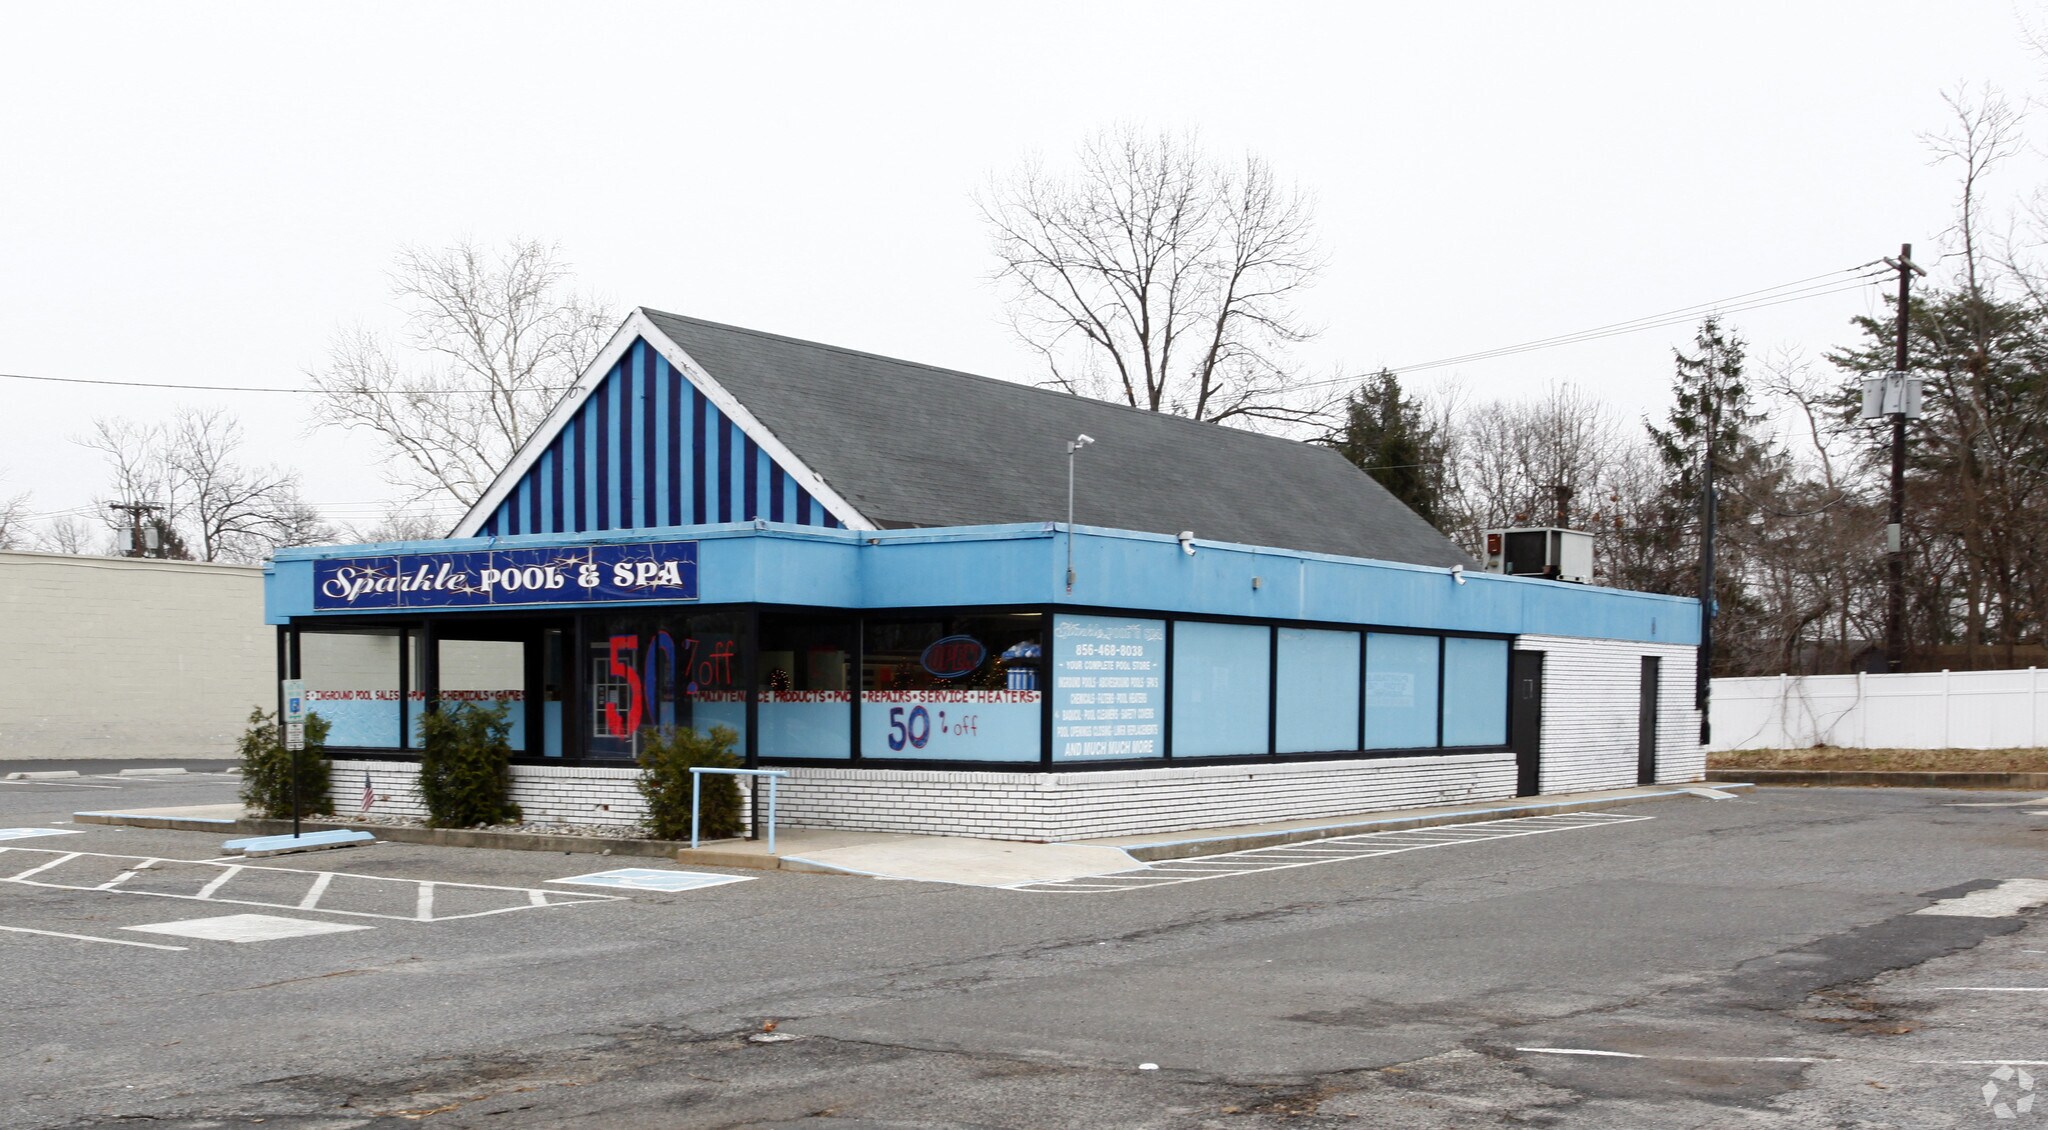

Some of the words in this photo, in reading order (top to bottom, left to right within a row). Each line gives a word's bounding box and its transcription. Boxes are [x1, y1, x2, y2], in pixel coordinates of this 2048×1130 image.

[323, 563, 467, 601] Sparkle
[480, 566, 564, 592] POOL
[577, 564, 600, 588] &
[613, 561, 683, 586] SPA
[1075, 644, 1143, 656] 856-468-8038
[1066, 661, 1083, 670] YOUR
[1084, 661, 1114, 670] COMPLETE
[1115, 661, 1131, 670] POOL
[1132, 661, 1151, 670] STORE
[315, 690, 354, 701] INGROUND
[356, 690, 373, 701] POOL
[375, 690, 399, 701] SALES
[441, 690, 490, 701] CHEMICALS
[774, 690, 826, 703] PRODUCTS
[867, 690, 911, 703] REPAIRS
[919, 690, 968, 703] SERVICE
[978, 690, 1035, 703] HEATERS
[888, 705, 930, 751] 50
[1064, 742, 1082, 756] AND
[1083, 742, 1107, 755] MUCH
[1108, 741, 1131, 754] MUCH
[1131, 740, 1154, 753] MORE
